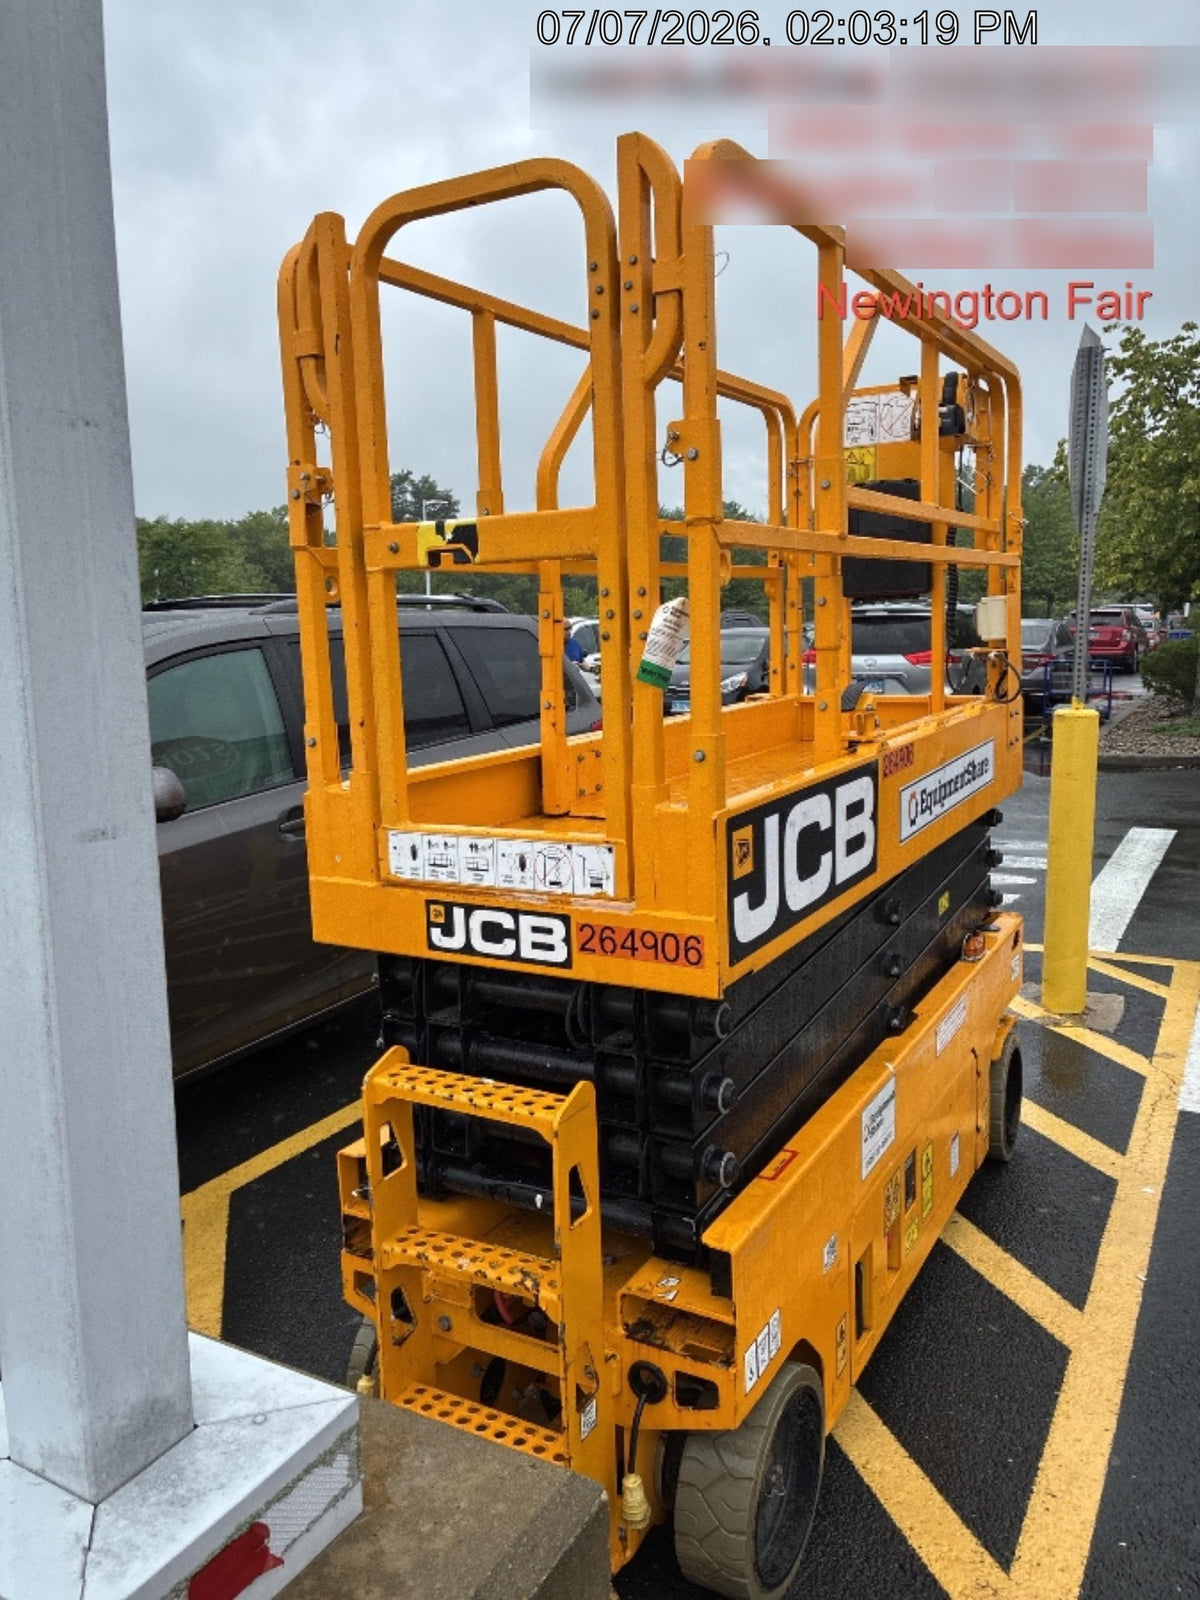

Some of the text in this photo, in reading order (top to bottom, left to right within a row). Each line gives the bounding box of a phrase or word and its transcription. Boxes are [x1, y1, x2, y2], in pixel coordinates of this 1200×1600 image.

[920, 757, 990, 815] EquipmentShare
[733, 776, 874, 943] JCB
[430, 905, 568, 963] JCB
[578, 923, 704, 966] 264906
